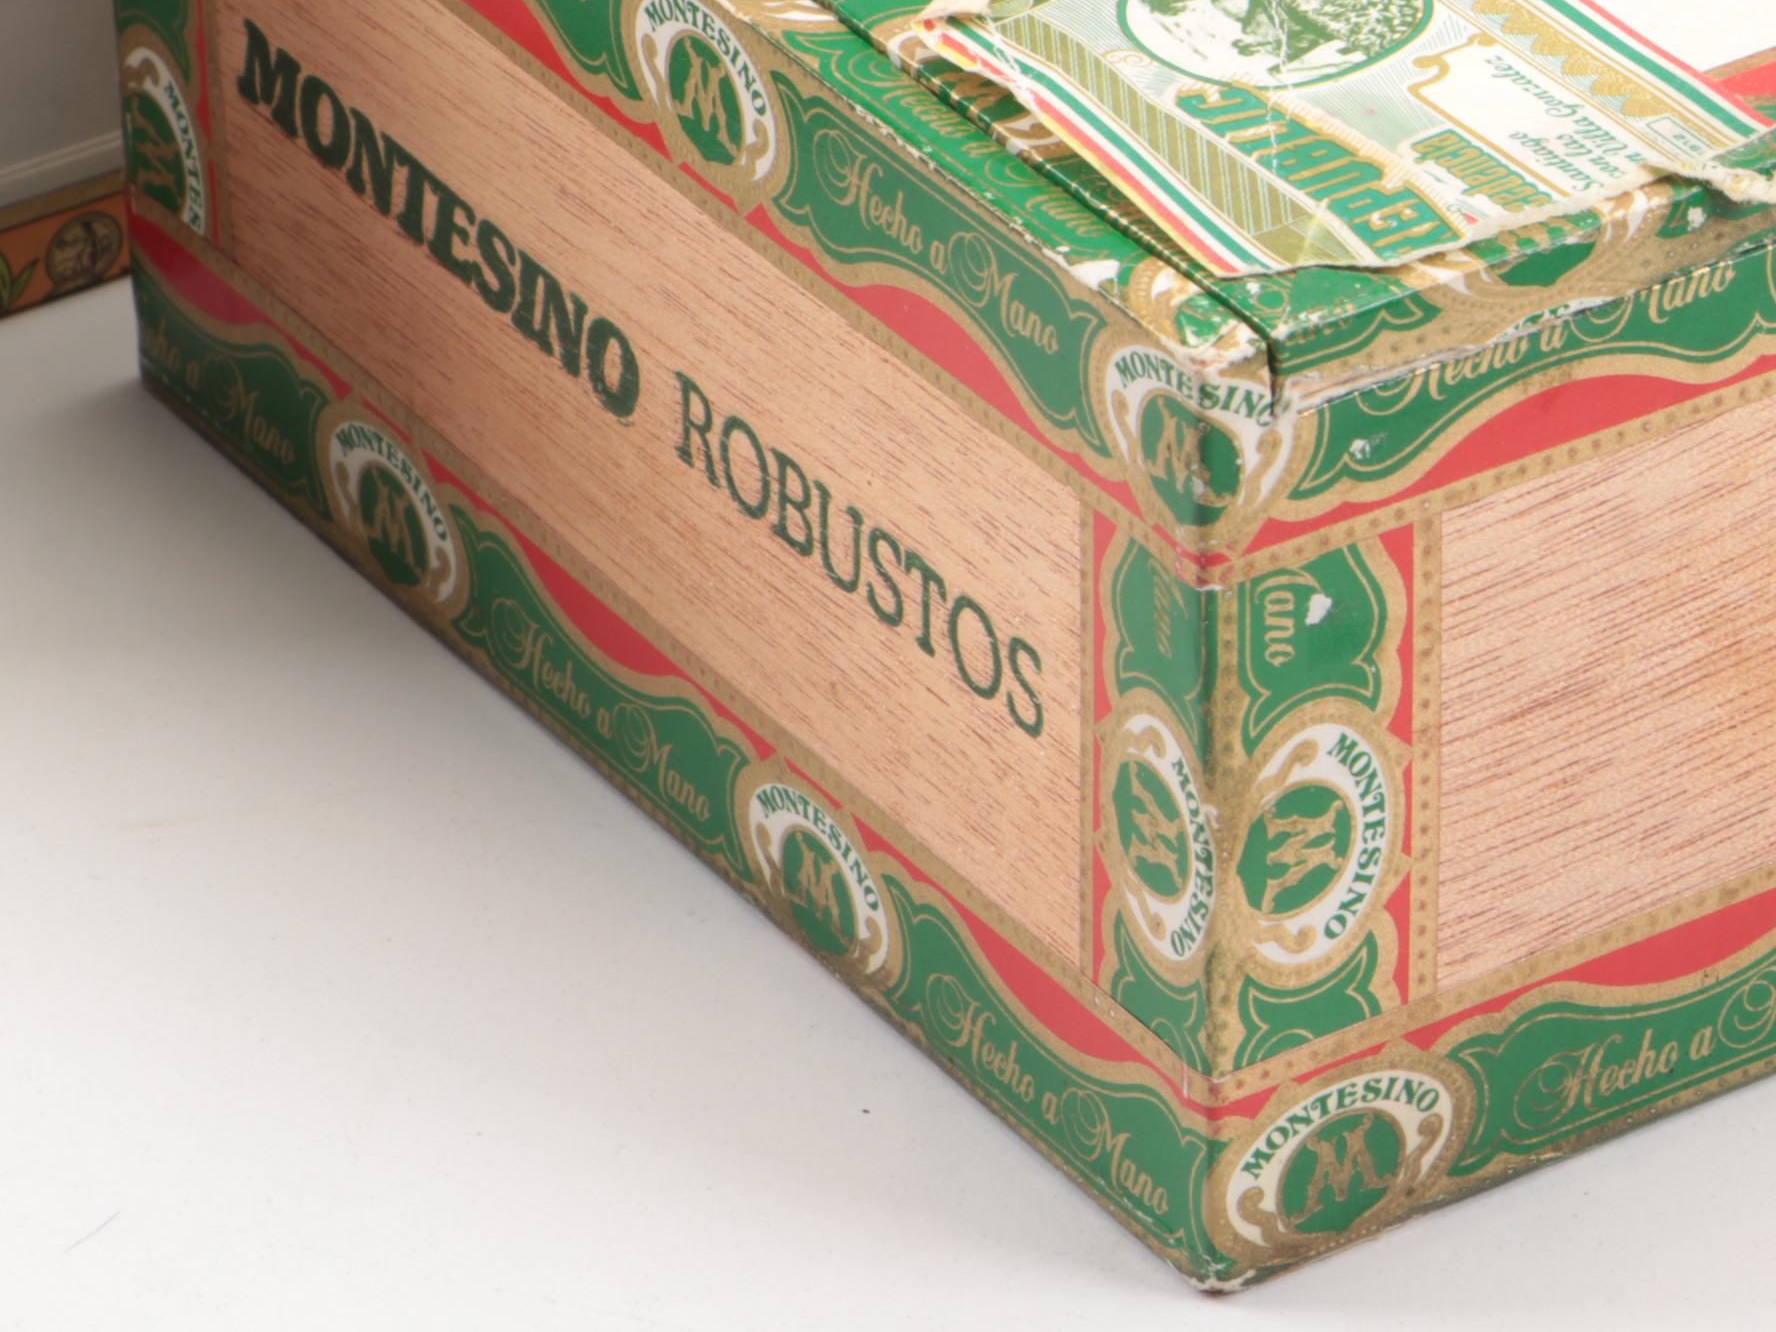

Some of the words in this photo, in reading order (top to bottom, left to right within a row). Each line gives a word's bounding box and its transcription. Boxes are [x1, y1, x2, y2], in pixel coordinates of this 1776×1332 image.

[1485, 54, 1585, 119] Gonzalez
[1557, 132, 1590, 158] las
[1571, 115, 1628, 157] Villa
[1508, 130, 1605, 192] Santiago
[811, 128, 923, 256] Hecho
[929, 239, 948, 276] a
[946, 231, 1060, 355] Mano
[238, 17, 641, 425] MONTESINO
[675, 368, 1045, 739] ROBUSTOS
[336, 422, 449, 543] MONTESINO
[491, 597, 591, 717] Hecho
[596, 708, 613, 738] a
[612, 701, 712, 823] Mano
[756, 783, 882, 913] MONTESINO
[1170, 755, 1216, 958] MONTESINO
[1323, 731, 1387, 941] MONTESINO
[925, 972, 1036, 1104] Hecho
[1041, 1088, 1061, 1126] a
[1059, 1086, 1170, 1217] Mano
[1241, 1076, 1440, 1182] MONTESINO
[1511, 1027, 1679, 1131] Hecho
[1690, 1030, 1717, 1063] a
